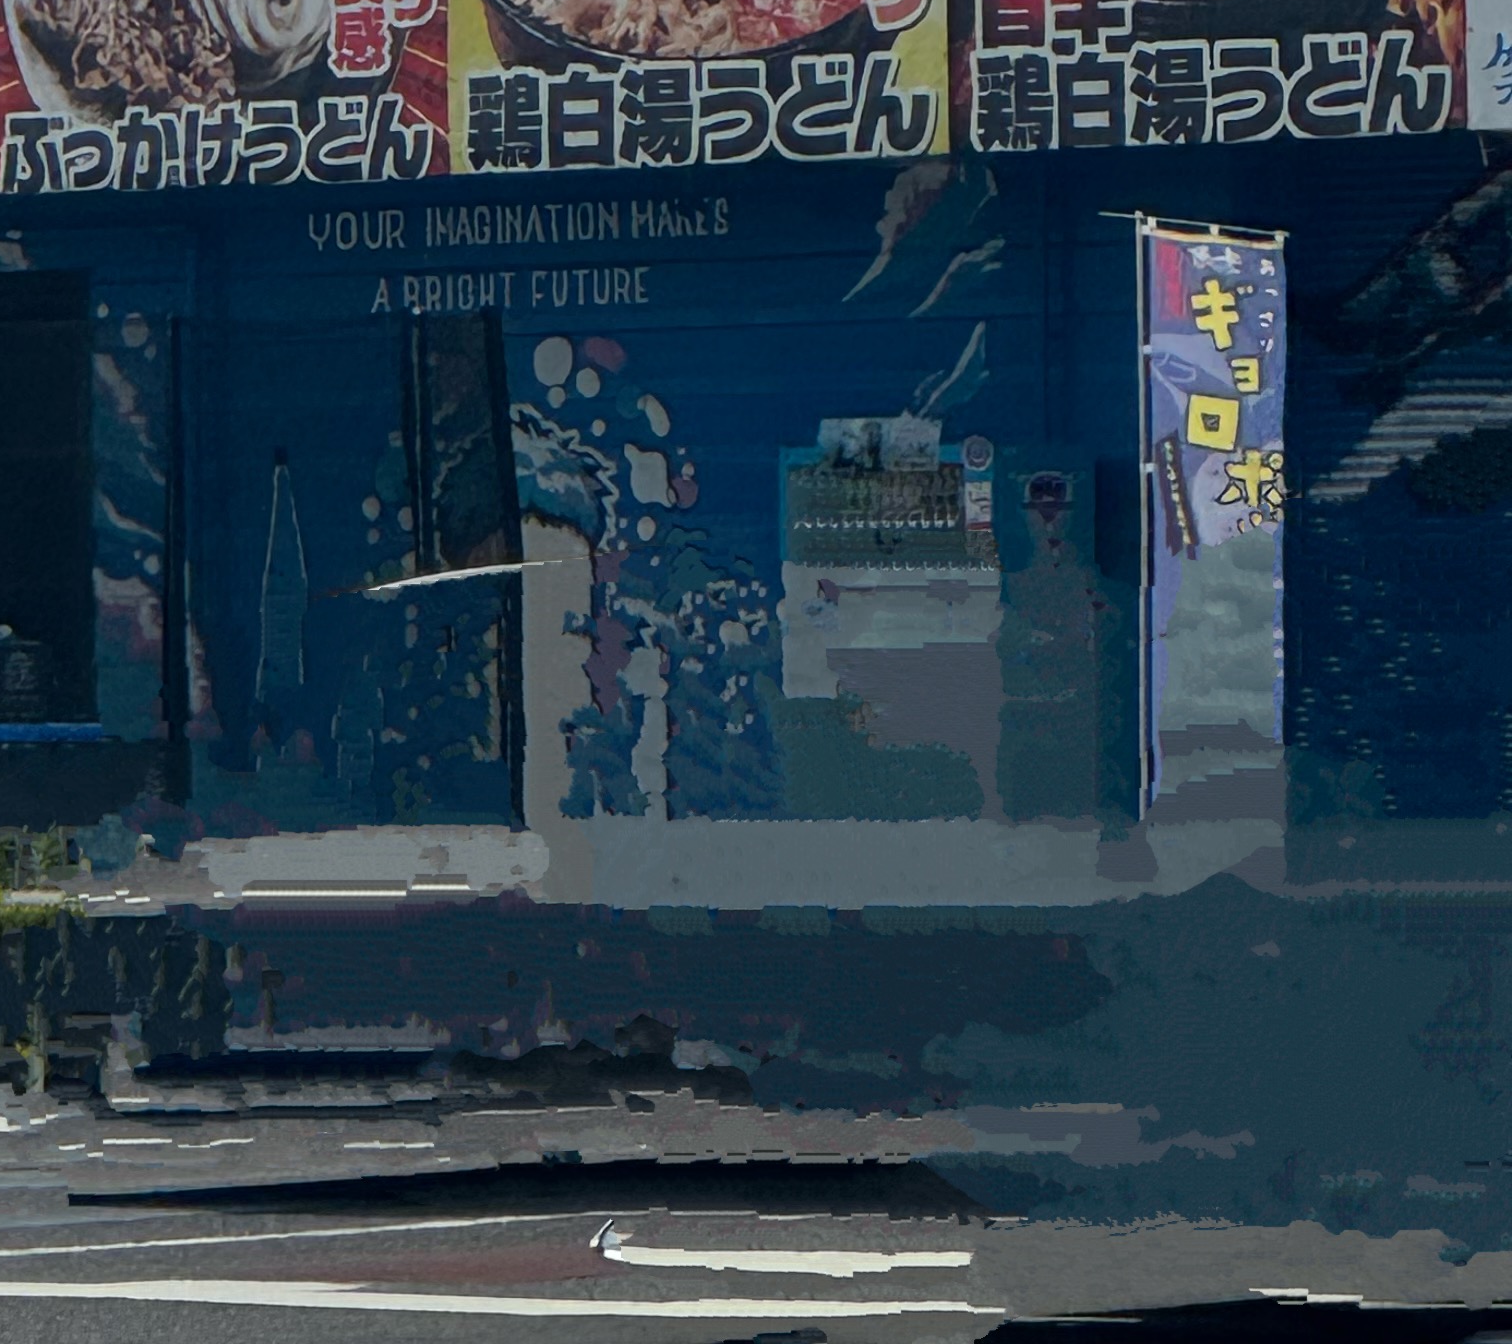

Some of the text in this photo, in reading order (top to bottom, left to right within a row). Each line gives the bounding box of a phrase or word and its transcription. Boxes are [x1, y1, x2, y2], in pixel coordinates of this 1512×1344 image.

[465, 51, 937, 172] 鶏白湯うどん
[971, 30, 1451, 152] 鶏白湯うどん
[308, 210, 406, 251] YOUR
[426, 201, 620, 248] IMAGINATION
[371, 266, 650, 313] A BRIGHT FUTURE
